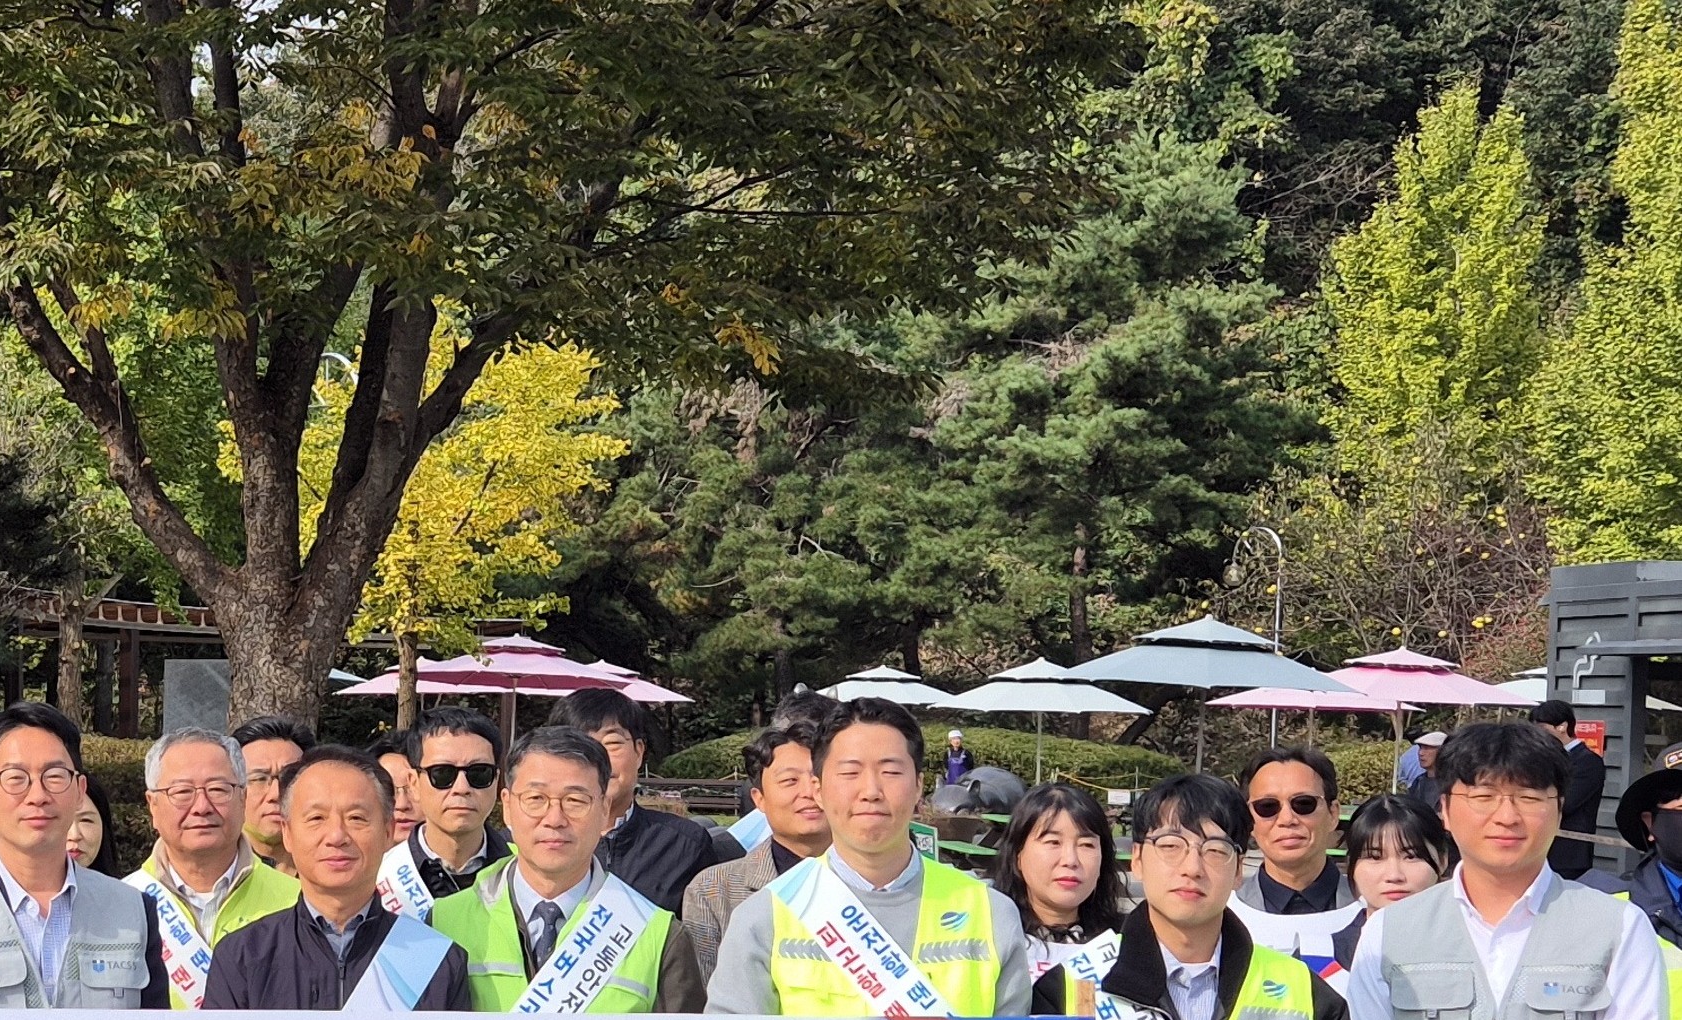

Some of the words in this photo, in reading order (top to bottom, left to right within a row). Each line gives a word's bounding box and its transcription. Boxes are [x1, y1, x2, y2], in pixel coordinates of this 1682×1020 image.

[816, 921, 886, 998] 피곤할
[841, 905, 909, 979] 운전할
[907, 981, 937, 1010] 땐
